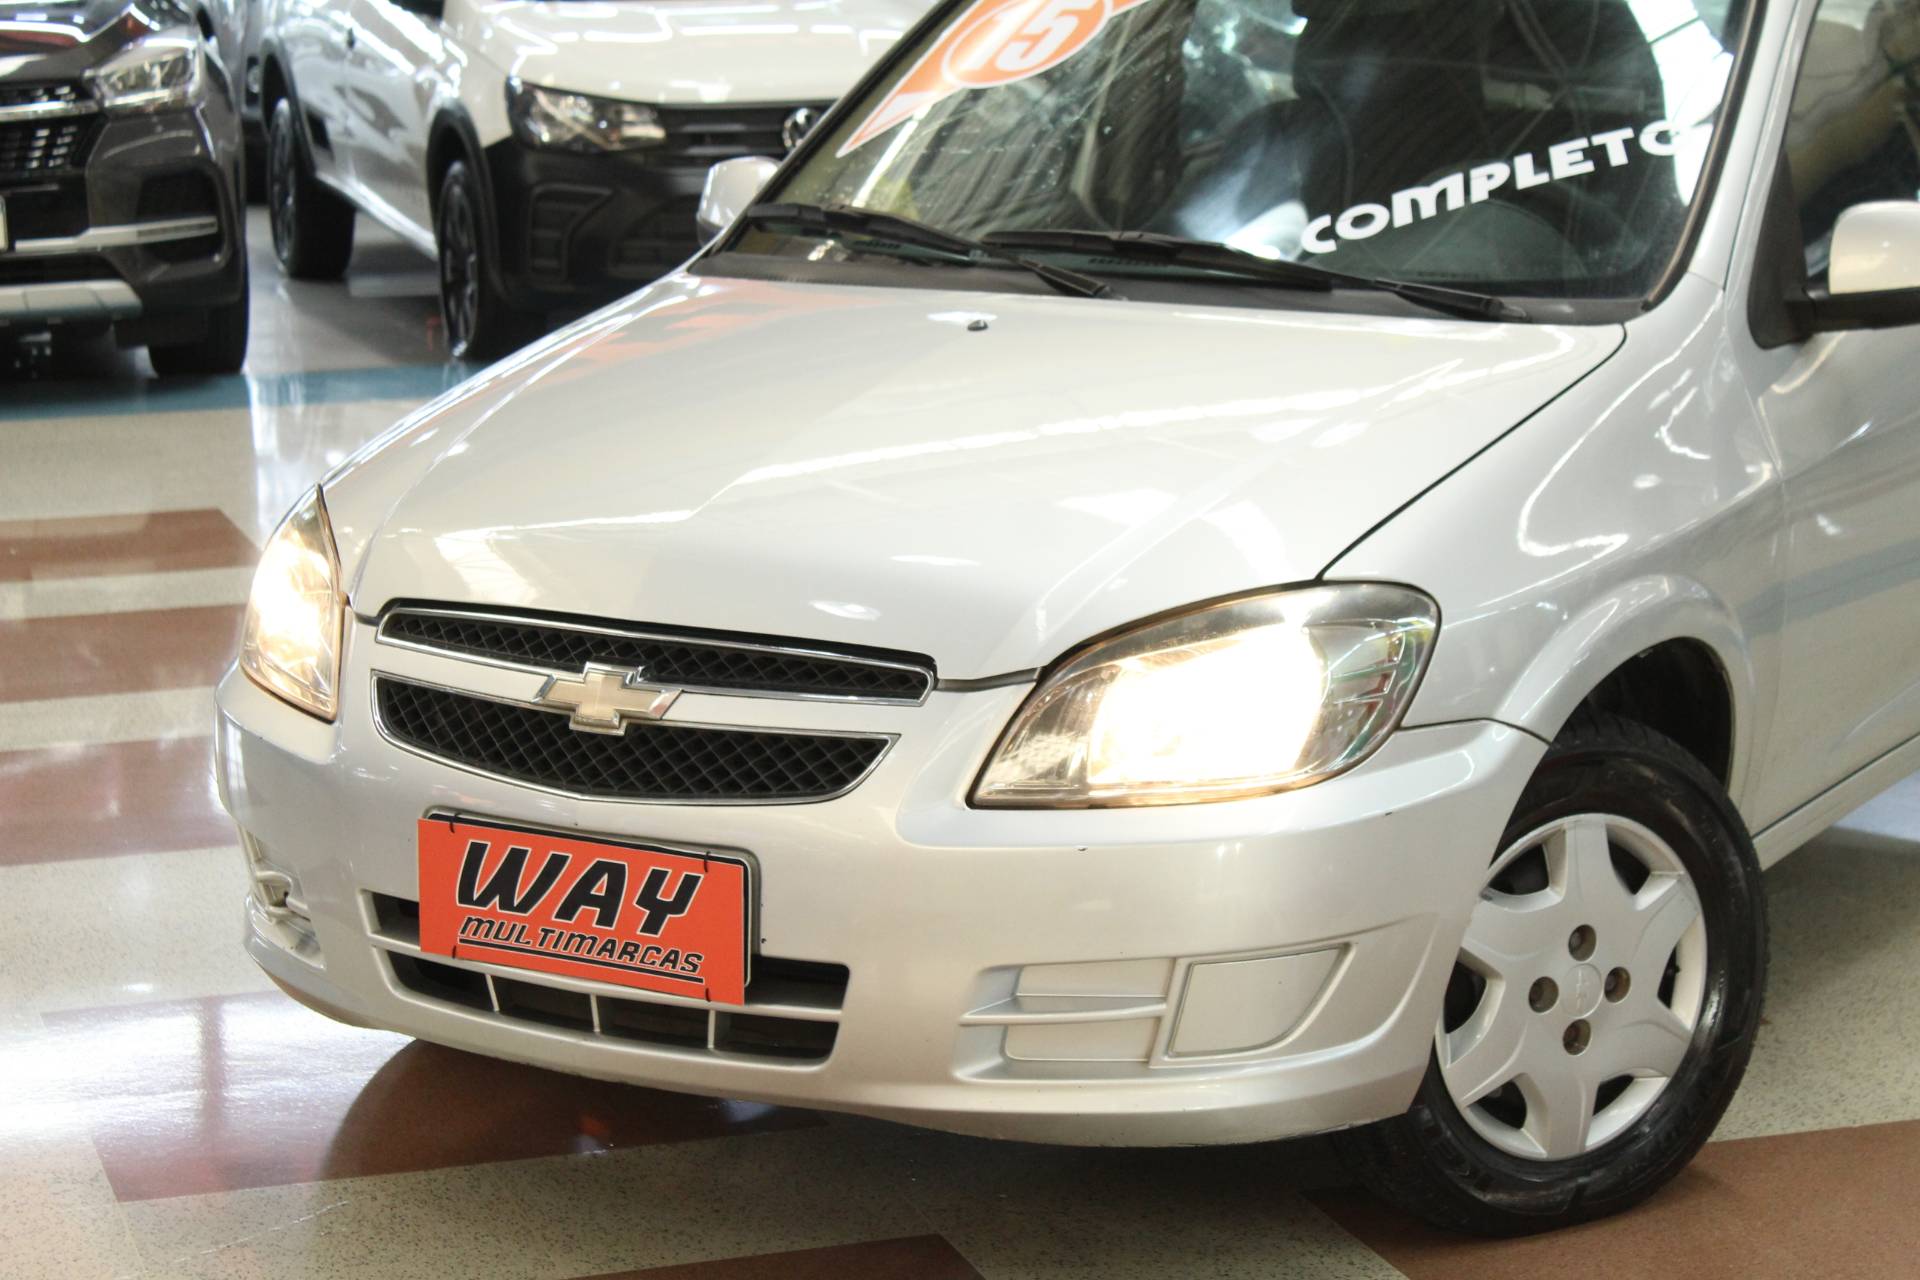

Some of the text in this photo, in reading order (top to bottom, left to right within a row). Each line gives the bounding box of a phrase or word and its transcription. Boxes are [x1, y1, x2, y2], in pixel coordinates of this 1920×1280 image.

[957, 0, 1095, 72] 15
[456, 839, 704, 937] WAY
[459, 915, 704, 973] MULTIMARCAS
